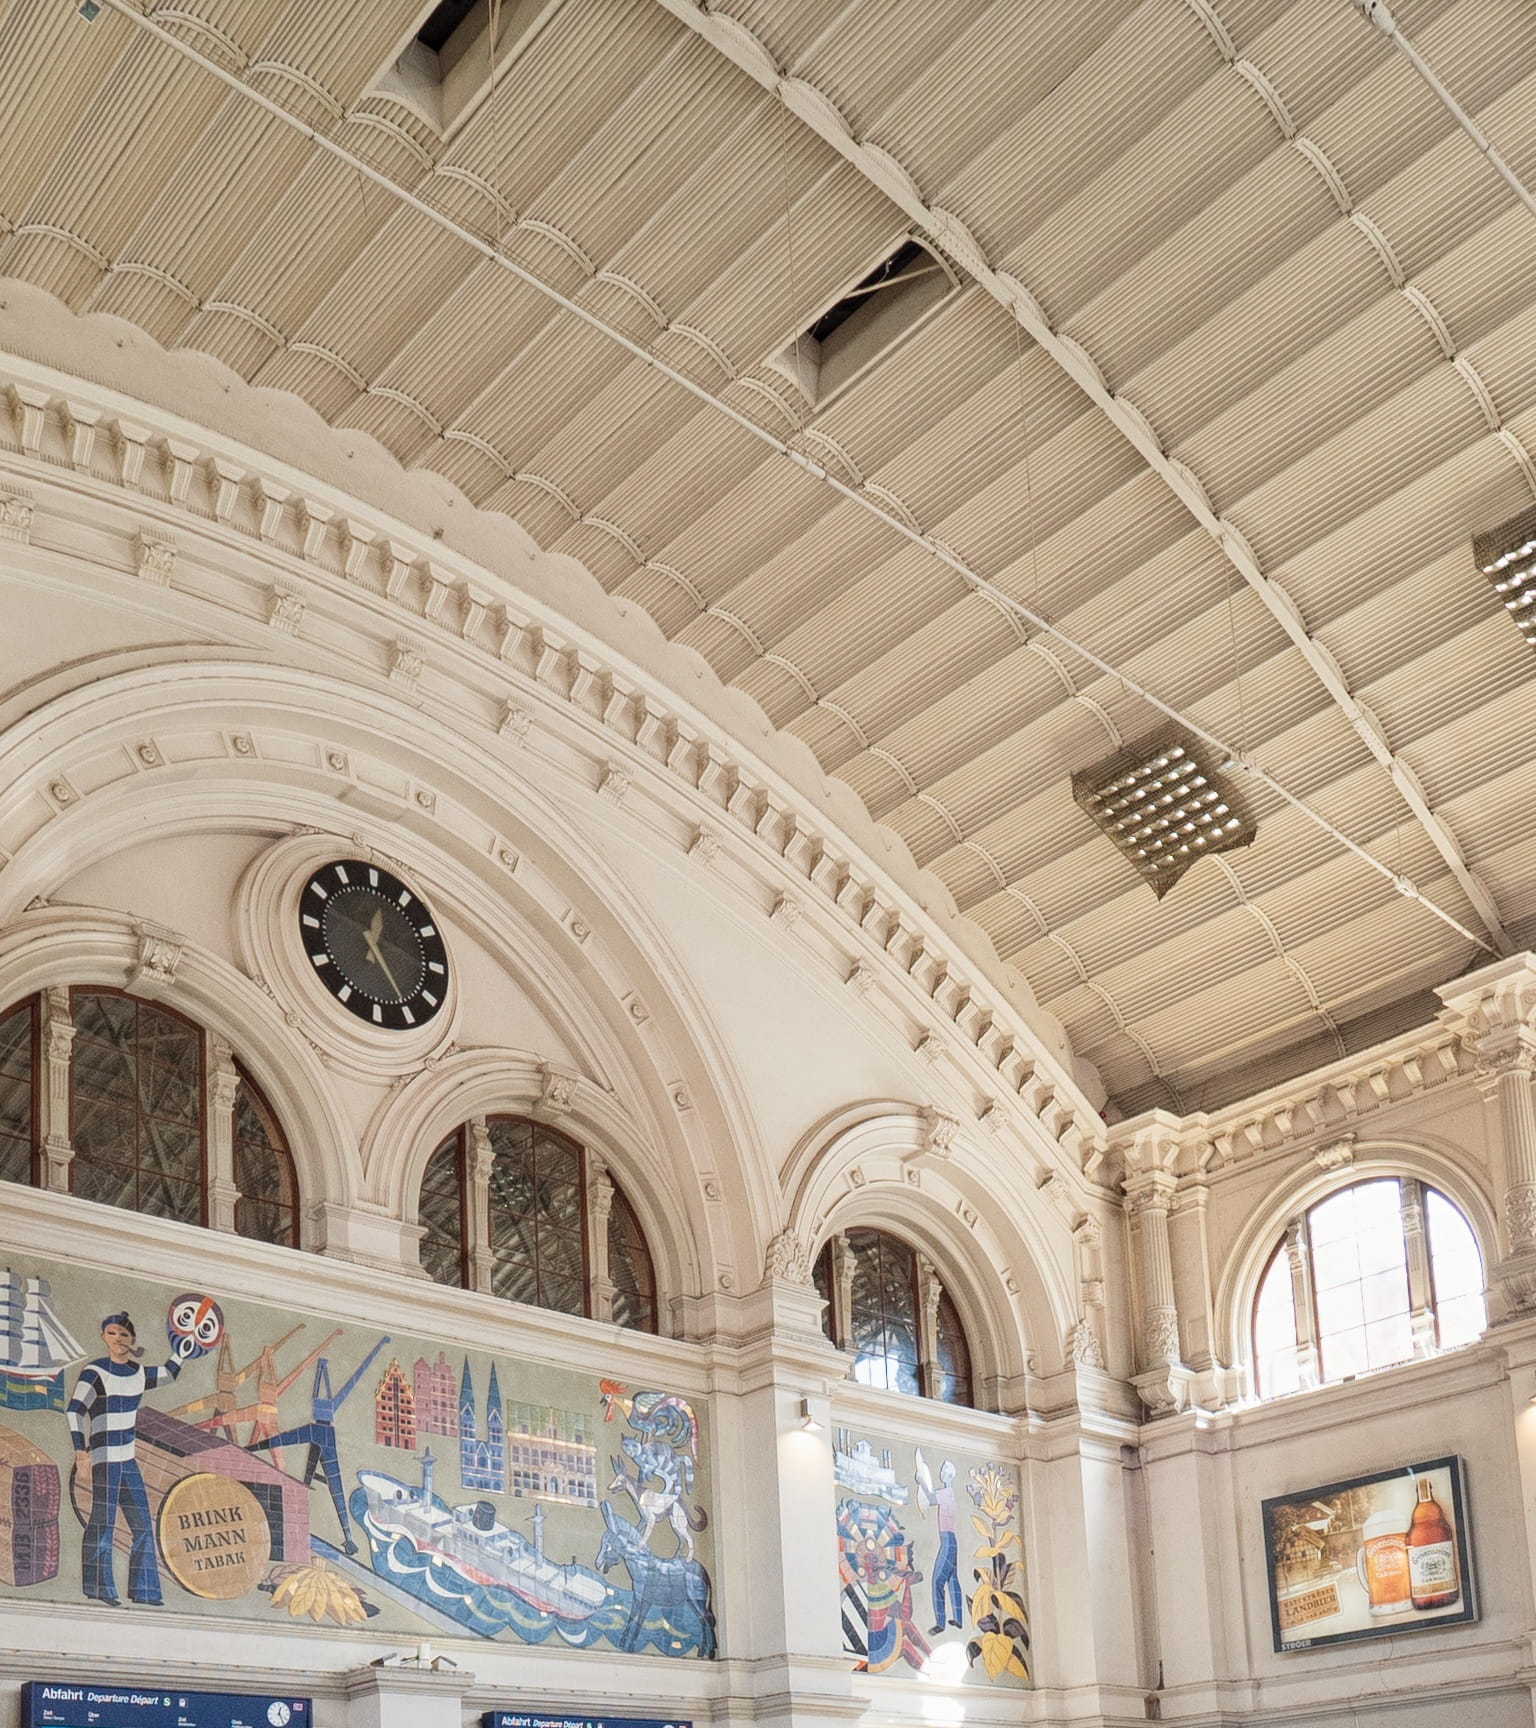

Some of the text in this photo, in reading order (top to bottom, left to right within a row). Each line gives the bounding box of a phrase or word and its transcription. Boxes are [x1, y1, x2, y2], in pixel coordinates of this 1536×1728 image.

[15, 1471, 30, 1519] 2336
[178, 1506, 243, 1531] BRINK
[183, 1529, 247, 1553] MANN
[194, 1552, 246, 1571] TABAK
[42, 1688, 83, 1701] Abfahrt
[88, 1692, 129, 1703] Departure
[130, 1694, 158, 1706] Départ
[501, 1716, 531, 1727] Abfahrt
